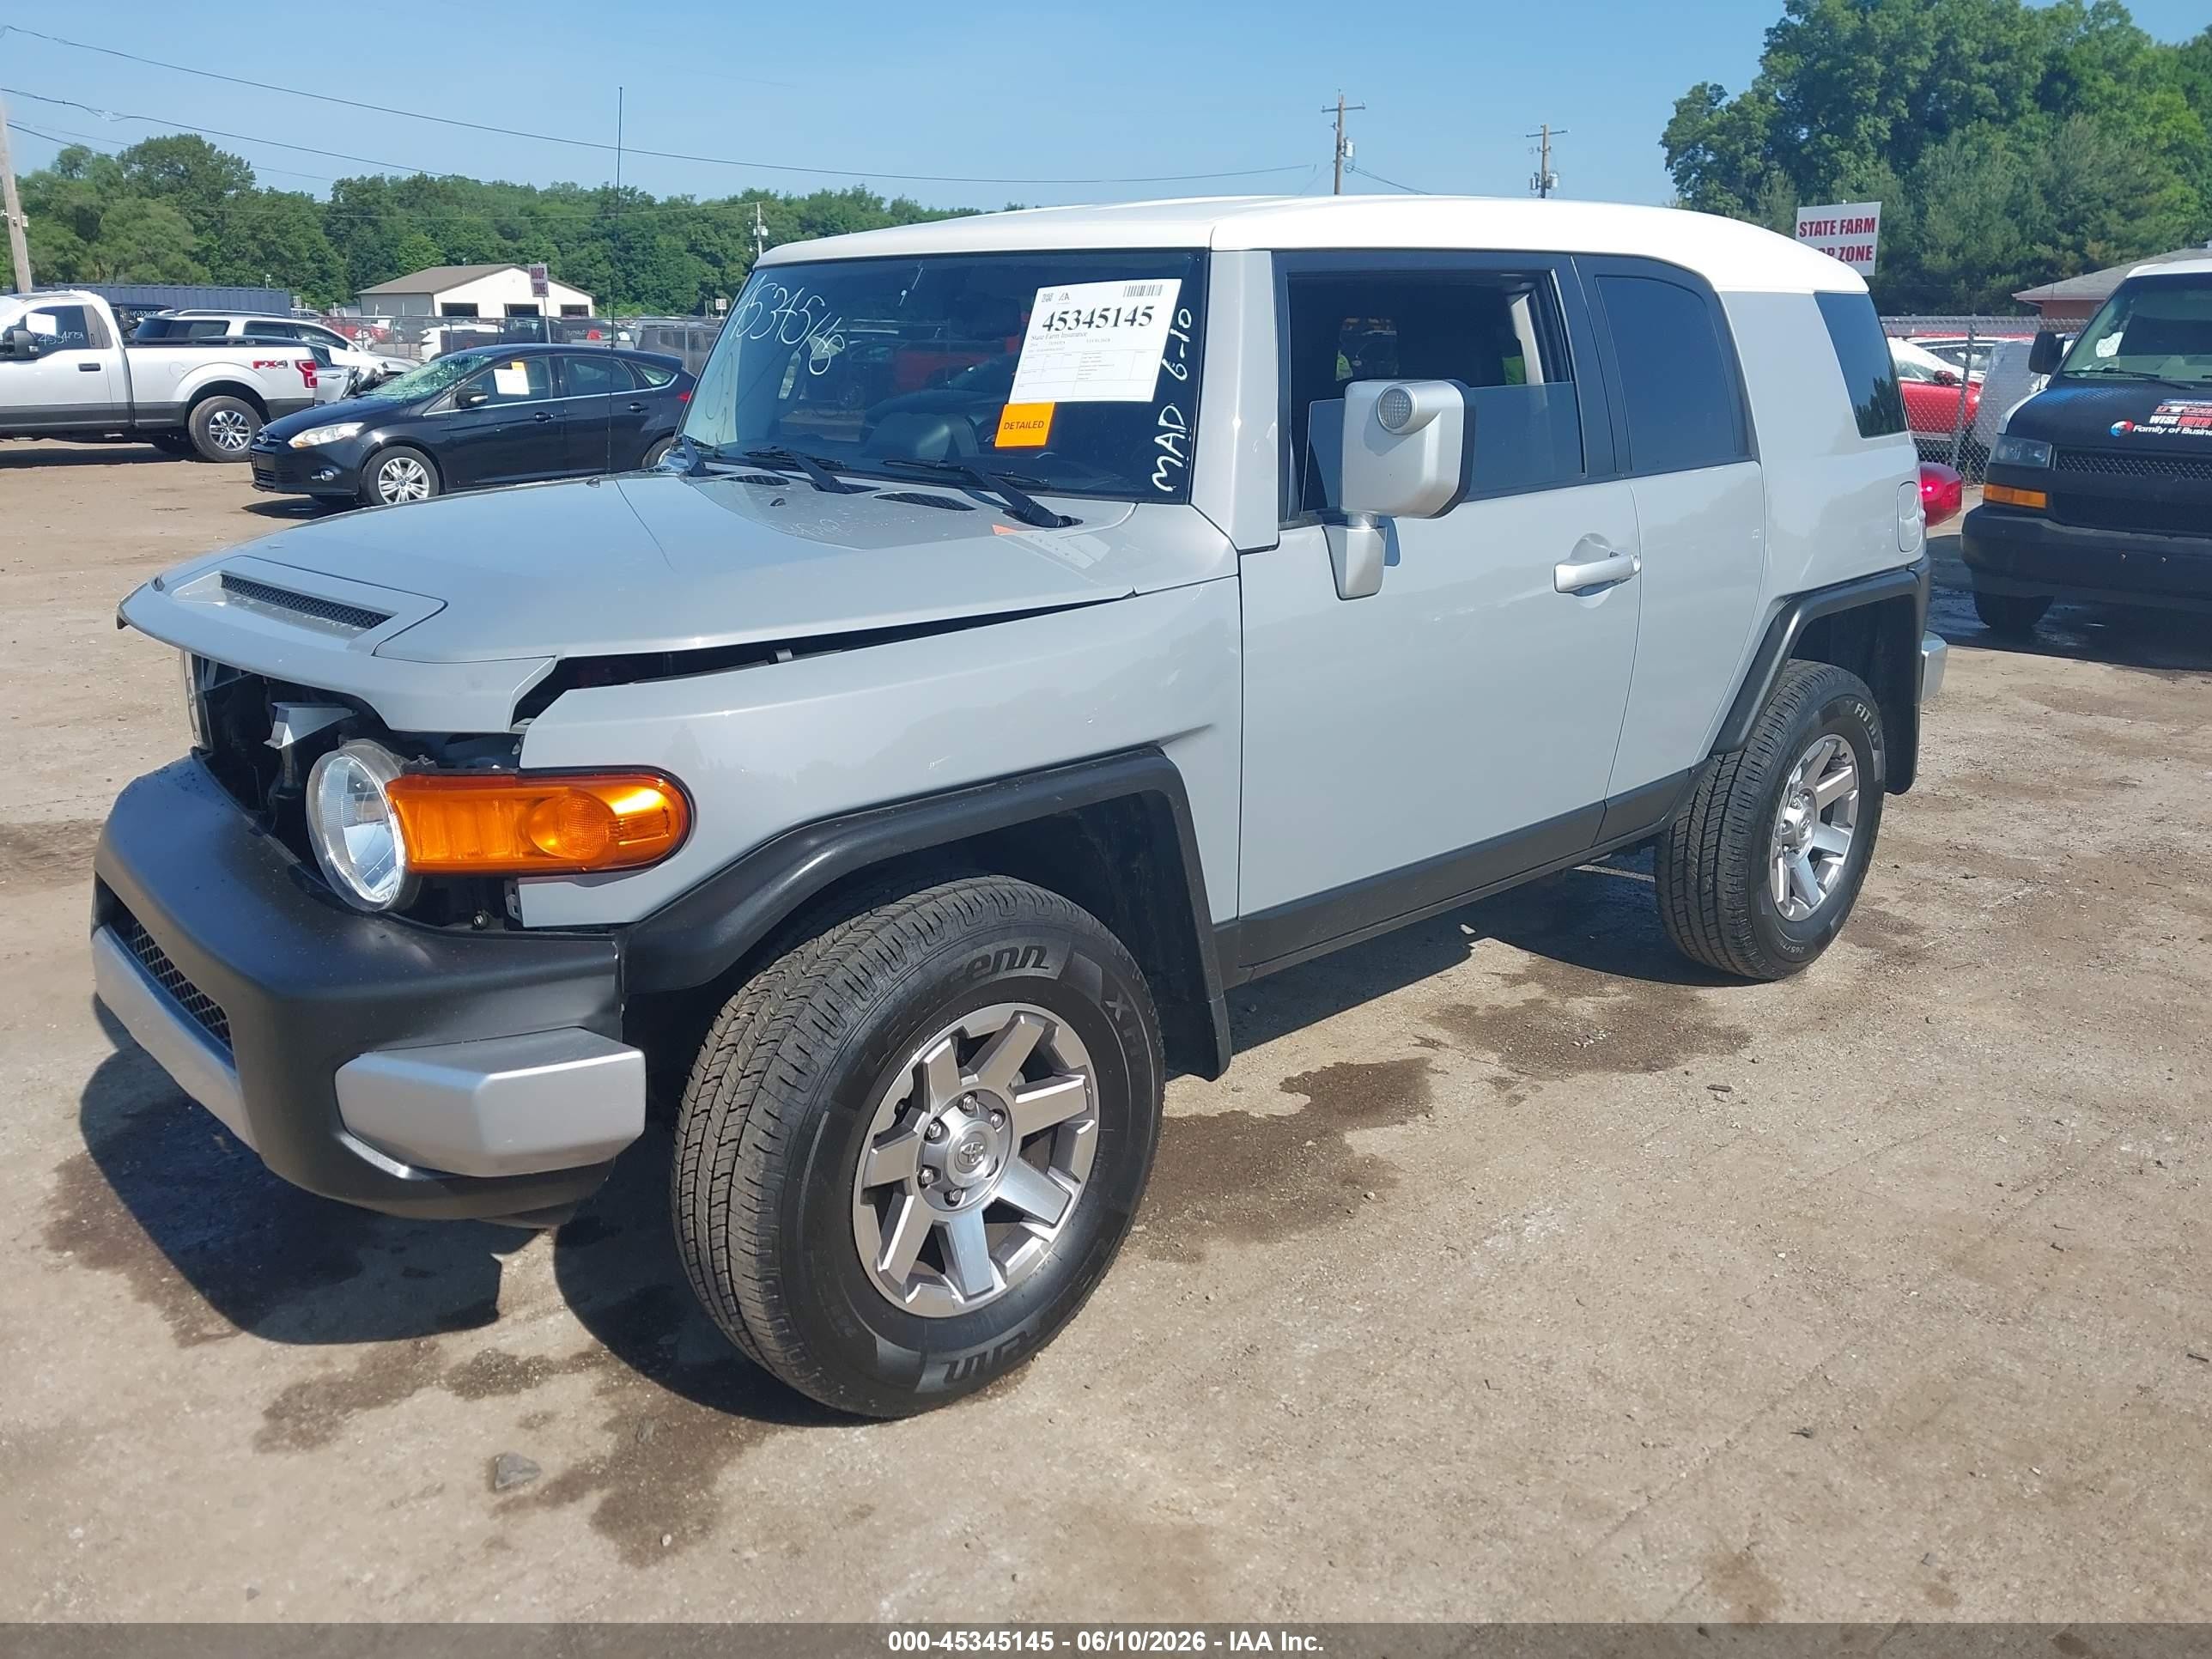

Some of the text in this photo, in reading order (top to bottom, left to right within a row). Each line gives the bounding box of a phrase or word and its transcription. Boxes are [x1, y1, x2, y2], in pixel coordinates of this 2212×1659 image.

[1799, 217, 1876, 238] STATE FARM
[1838, 245, 1874, 263] ZONE
[1042, 305, 1155, 332] 45345145
[252, 360, 289, 369] FX4
[1004, 420, 1045, 430] DETAILED
[2148, 415, 2180, 425] WISE
[2132, 424, 2167, 434] Family
[2167, 426, 2180, 434] of
[1152, 402, 1188, 492] MAD
